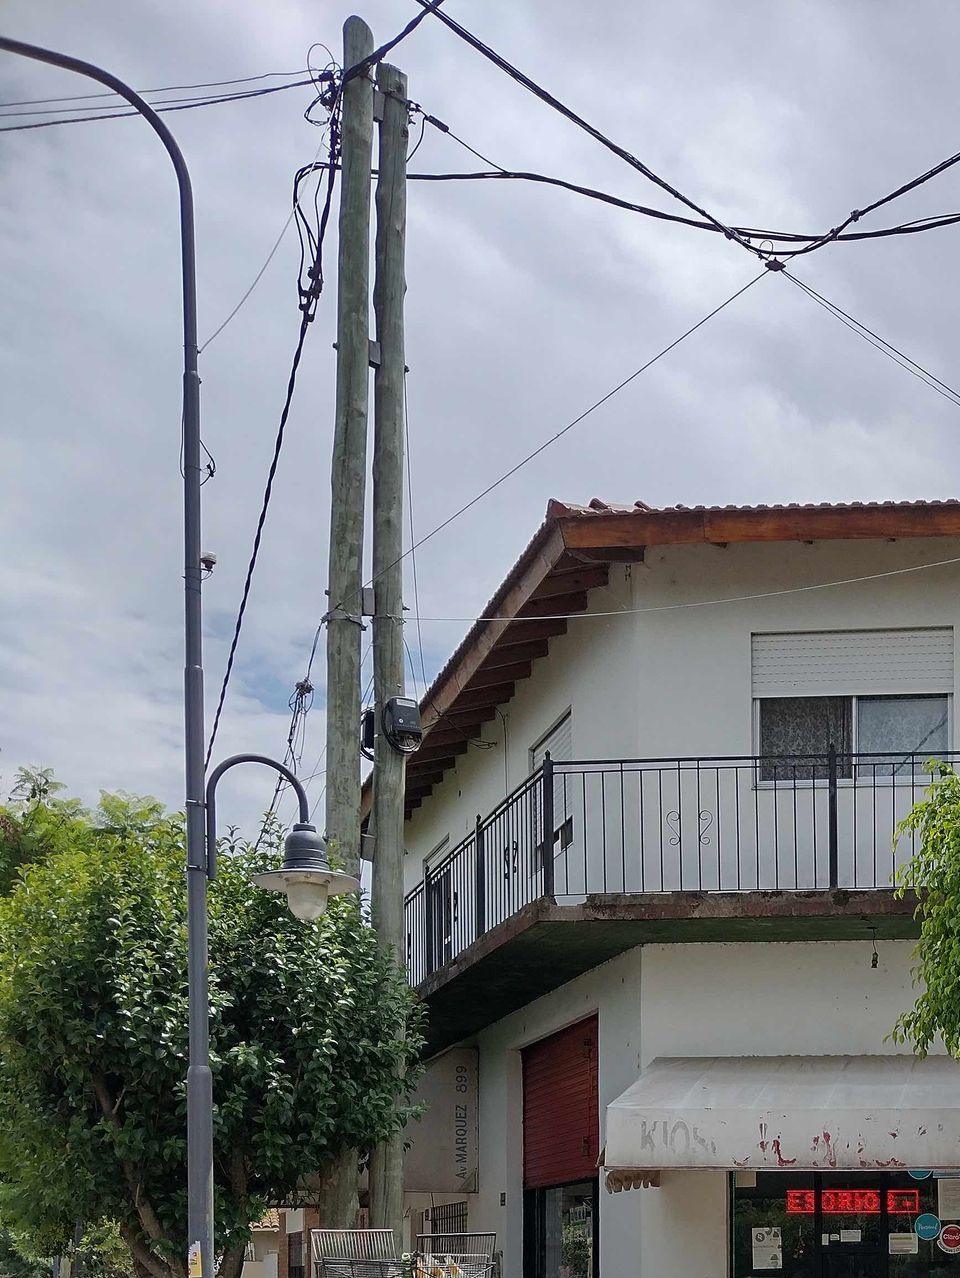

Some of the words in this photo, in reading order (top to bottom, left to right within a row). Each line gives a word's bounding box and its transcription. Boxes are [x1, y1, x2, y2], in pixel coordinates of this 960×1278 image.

[455, 1065, 468, 1093] 899
[455, 1104, 468, 1163] MARQUEZ
[640, 1120, 717, 1155] KIOS
